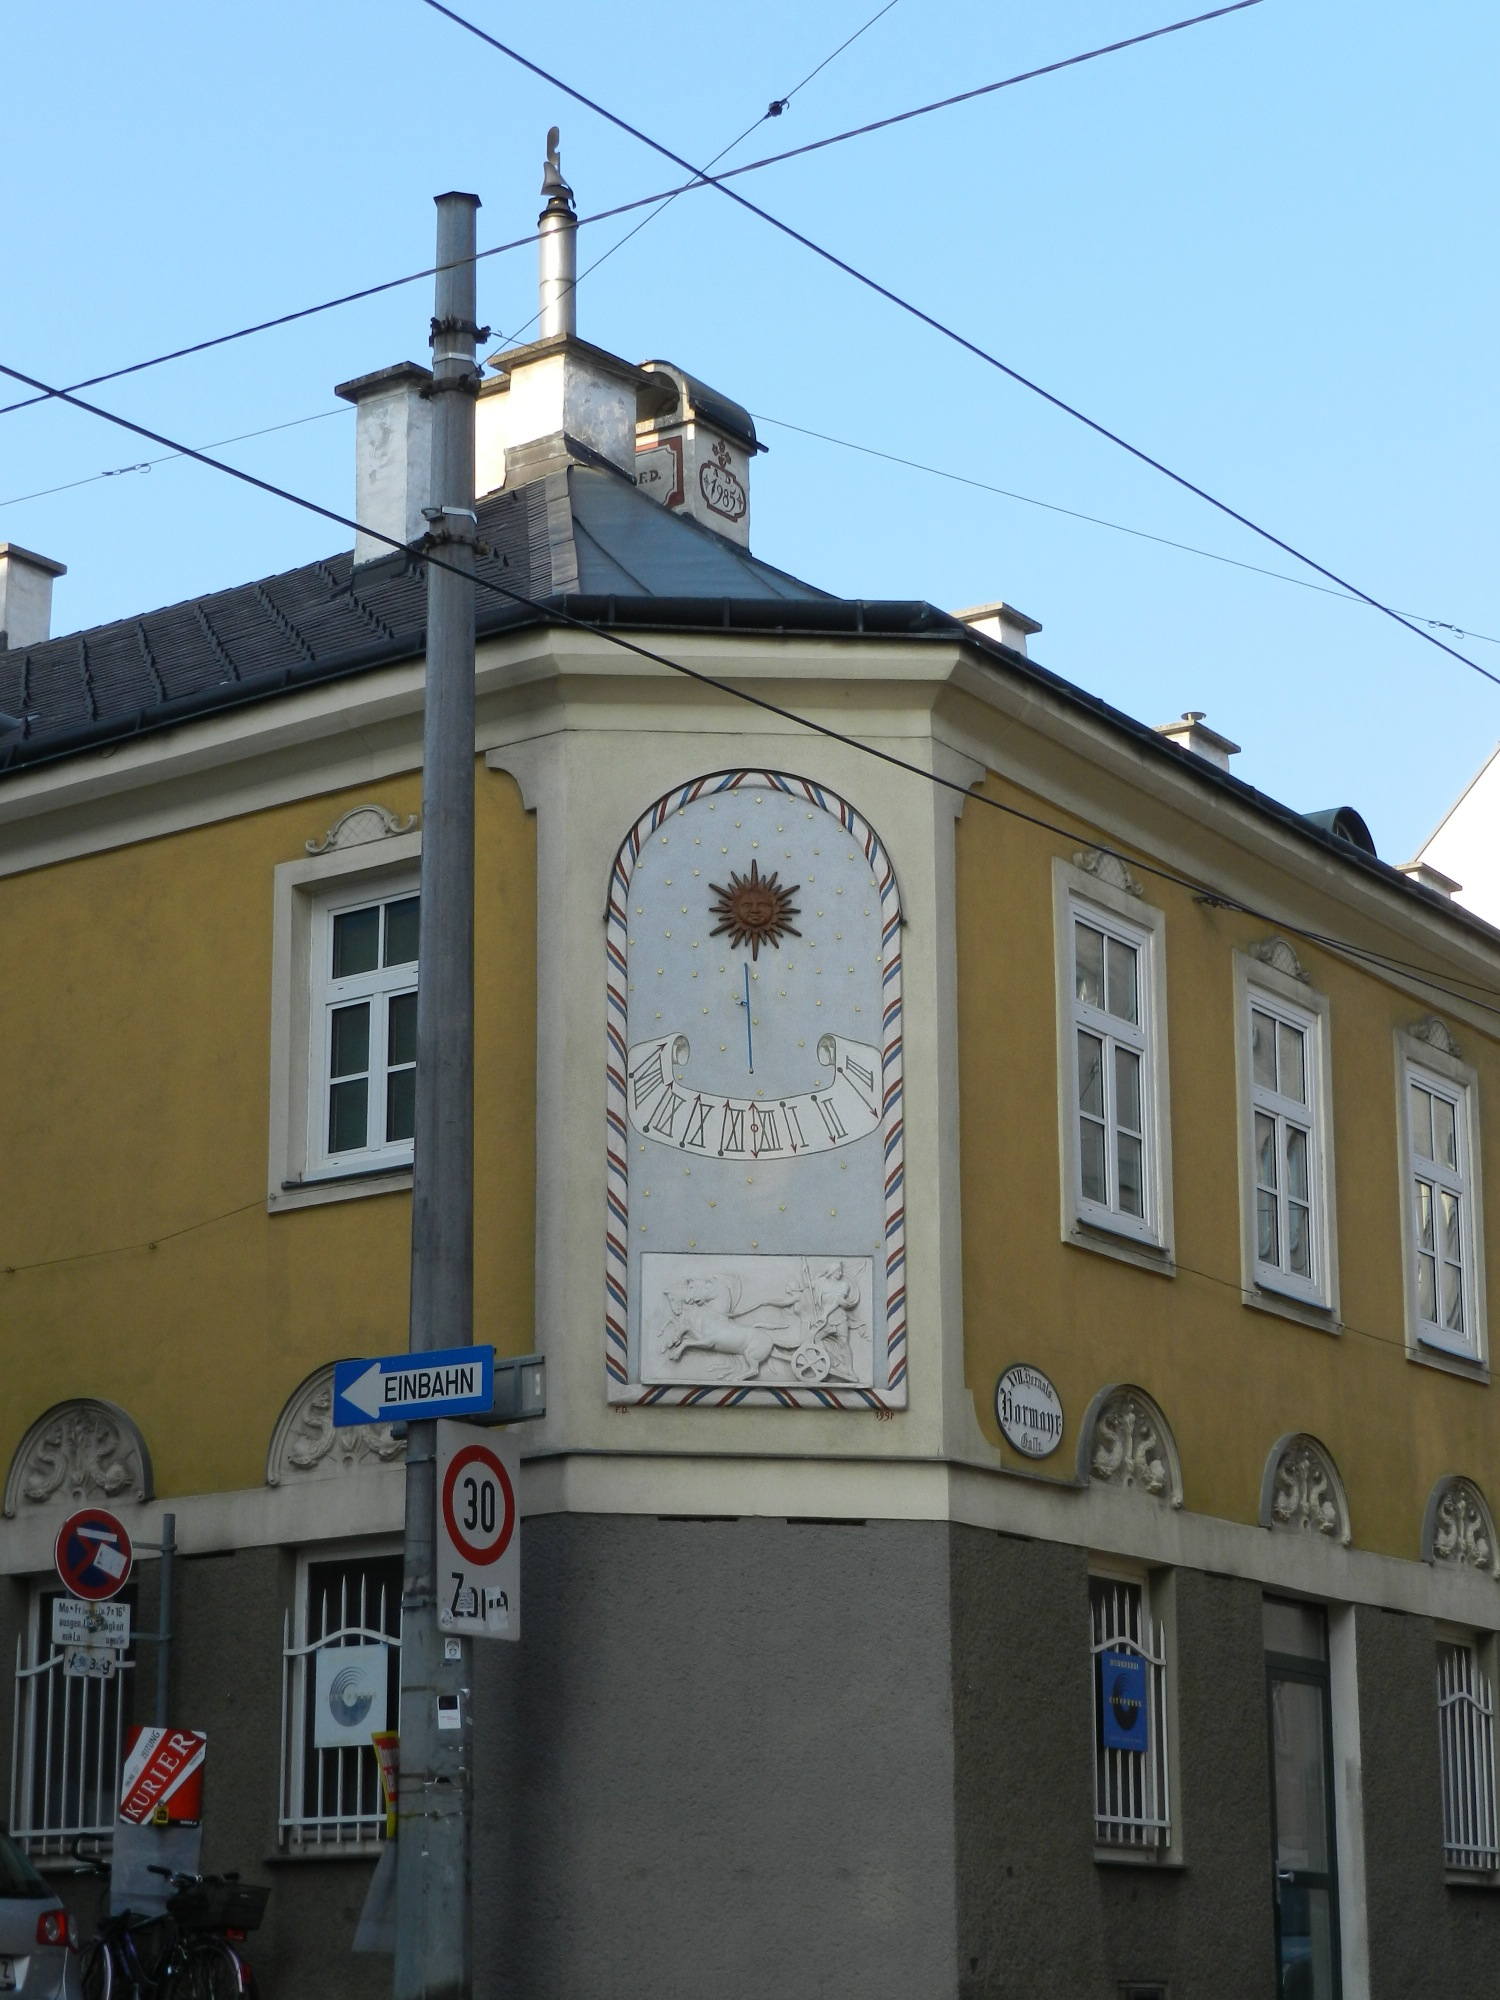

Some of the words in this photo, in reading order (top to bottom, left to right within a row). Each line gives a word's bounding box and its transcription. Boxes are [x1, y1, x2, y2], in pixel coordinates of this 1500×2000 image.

[710, 478, 737, 513] 1985
[845, 1054, 874, 1093] III
[687, 1103, 715, 1148] X
[724, 1108, 746, 1152] XI
[757, 1109, 784, 1152] XII
[384, 1367, 474, 1403] EINBAHN
[463, 1477, 495, 1533] 30
[125, 1732, 196, 1819] KURIER
